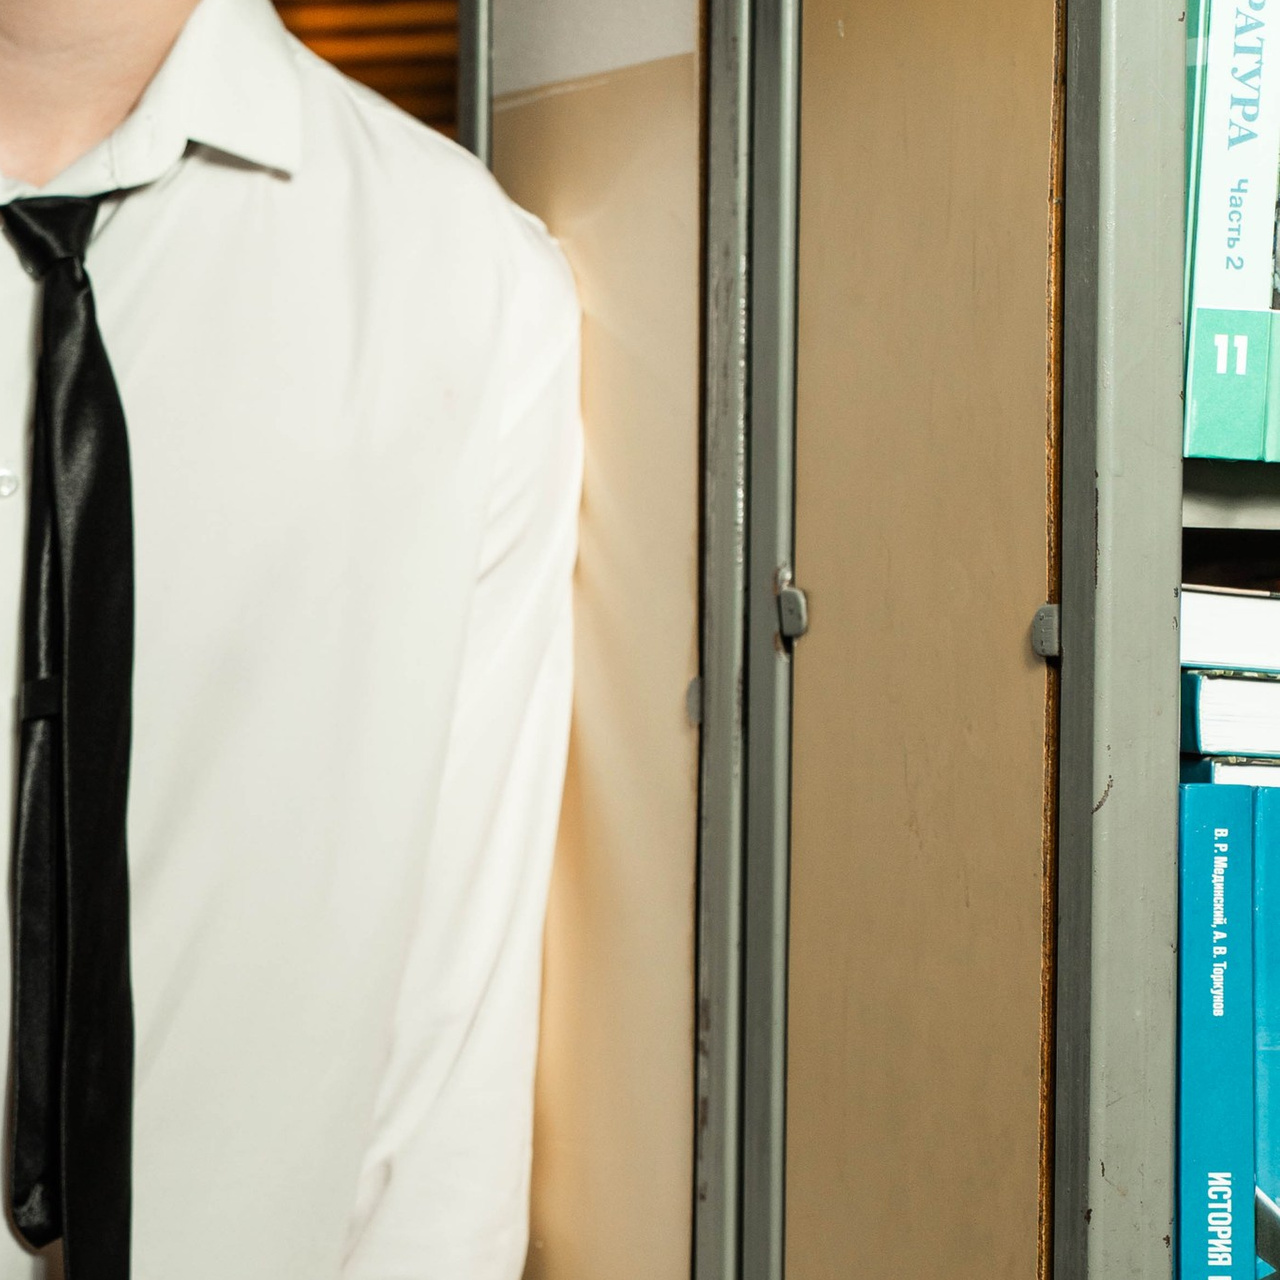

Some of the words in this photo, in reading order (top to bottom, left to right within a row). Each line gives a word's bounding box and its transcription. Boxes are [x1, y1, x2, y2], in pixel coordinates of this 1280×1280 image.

[1227, 178, 1249, 250] Часть
[1225, 255, 1245, 271] 2
[1213, 333, 1249, 376] 11
[1213, 842, 1229, 854] Р.
[1214, 827, 1229, 841] В.
[1210, 855, 1228, 928] Мединский,
[1212, 930, 1228, 944] А.
[1212, 945, 1228, 959] В.
[1210, 960, 1228, 1017] Торкунов
[1207, 1171, 1233, 1266] ИСТОРИЯ
